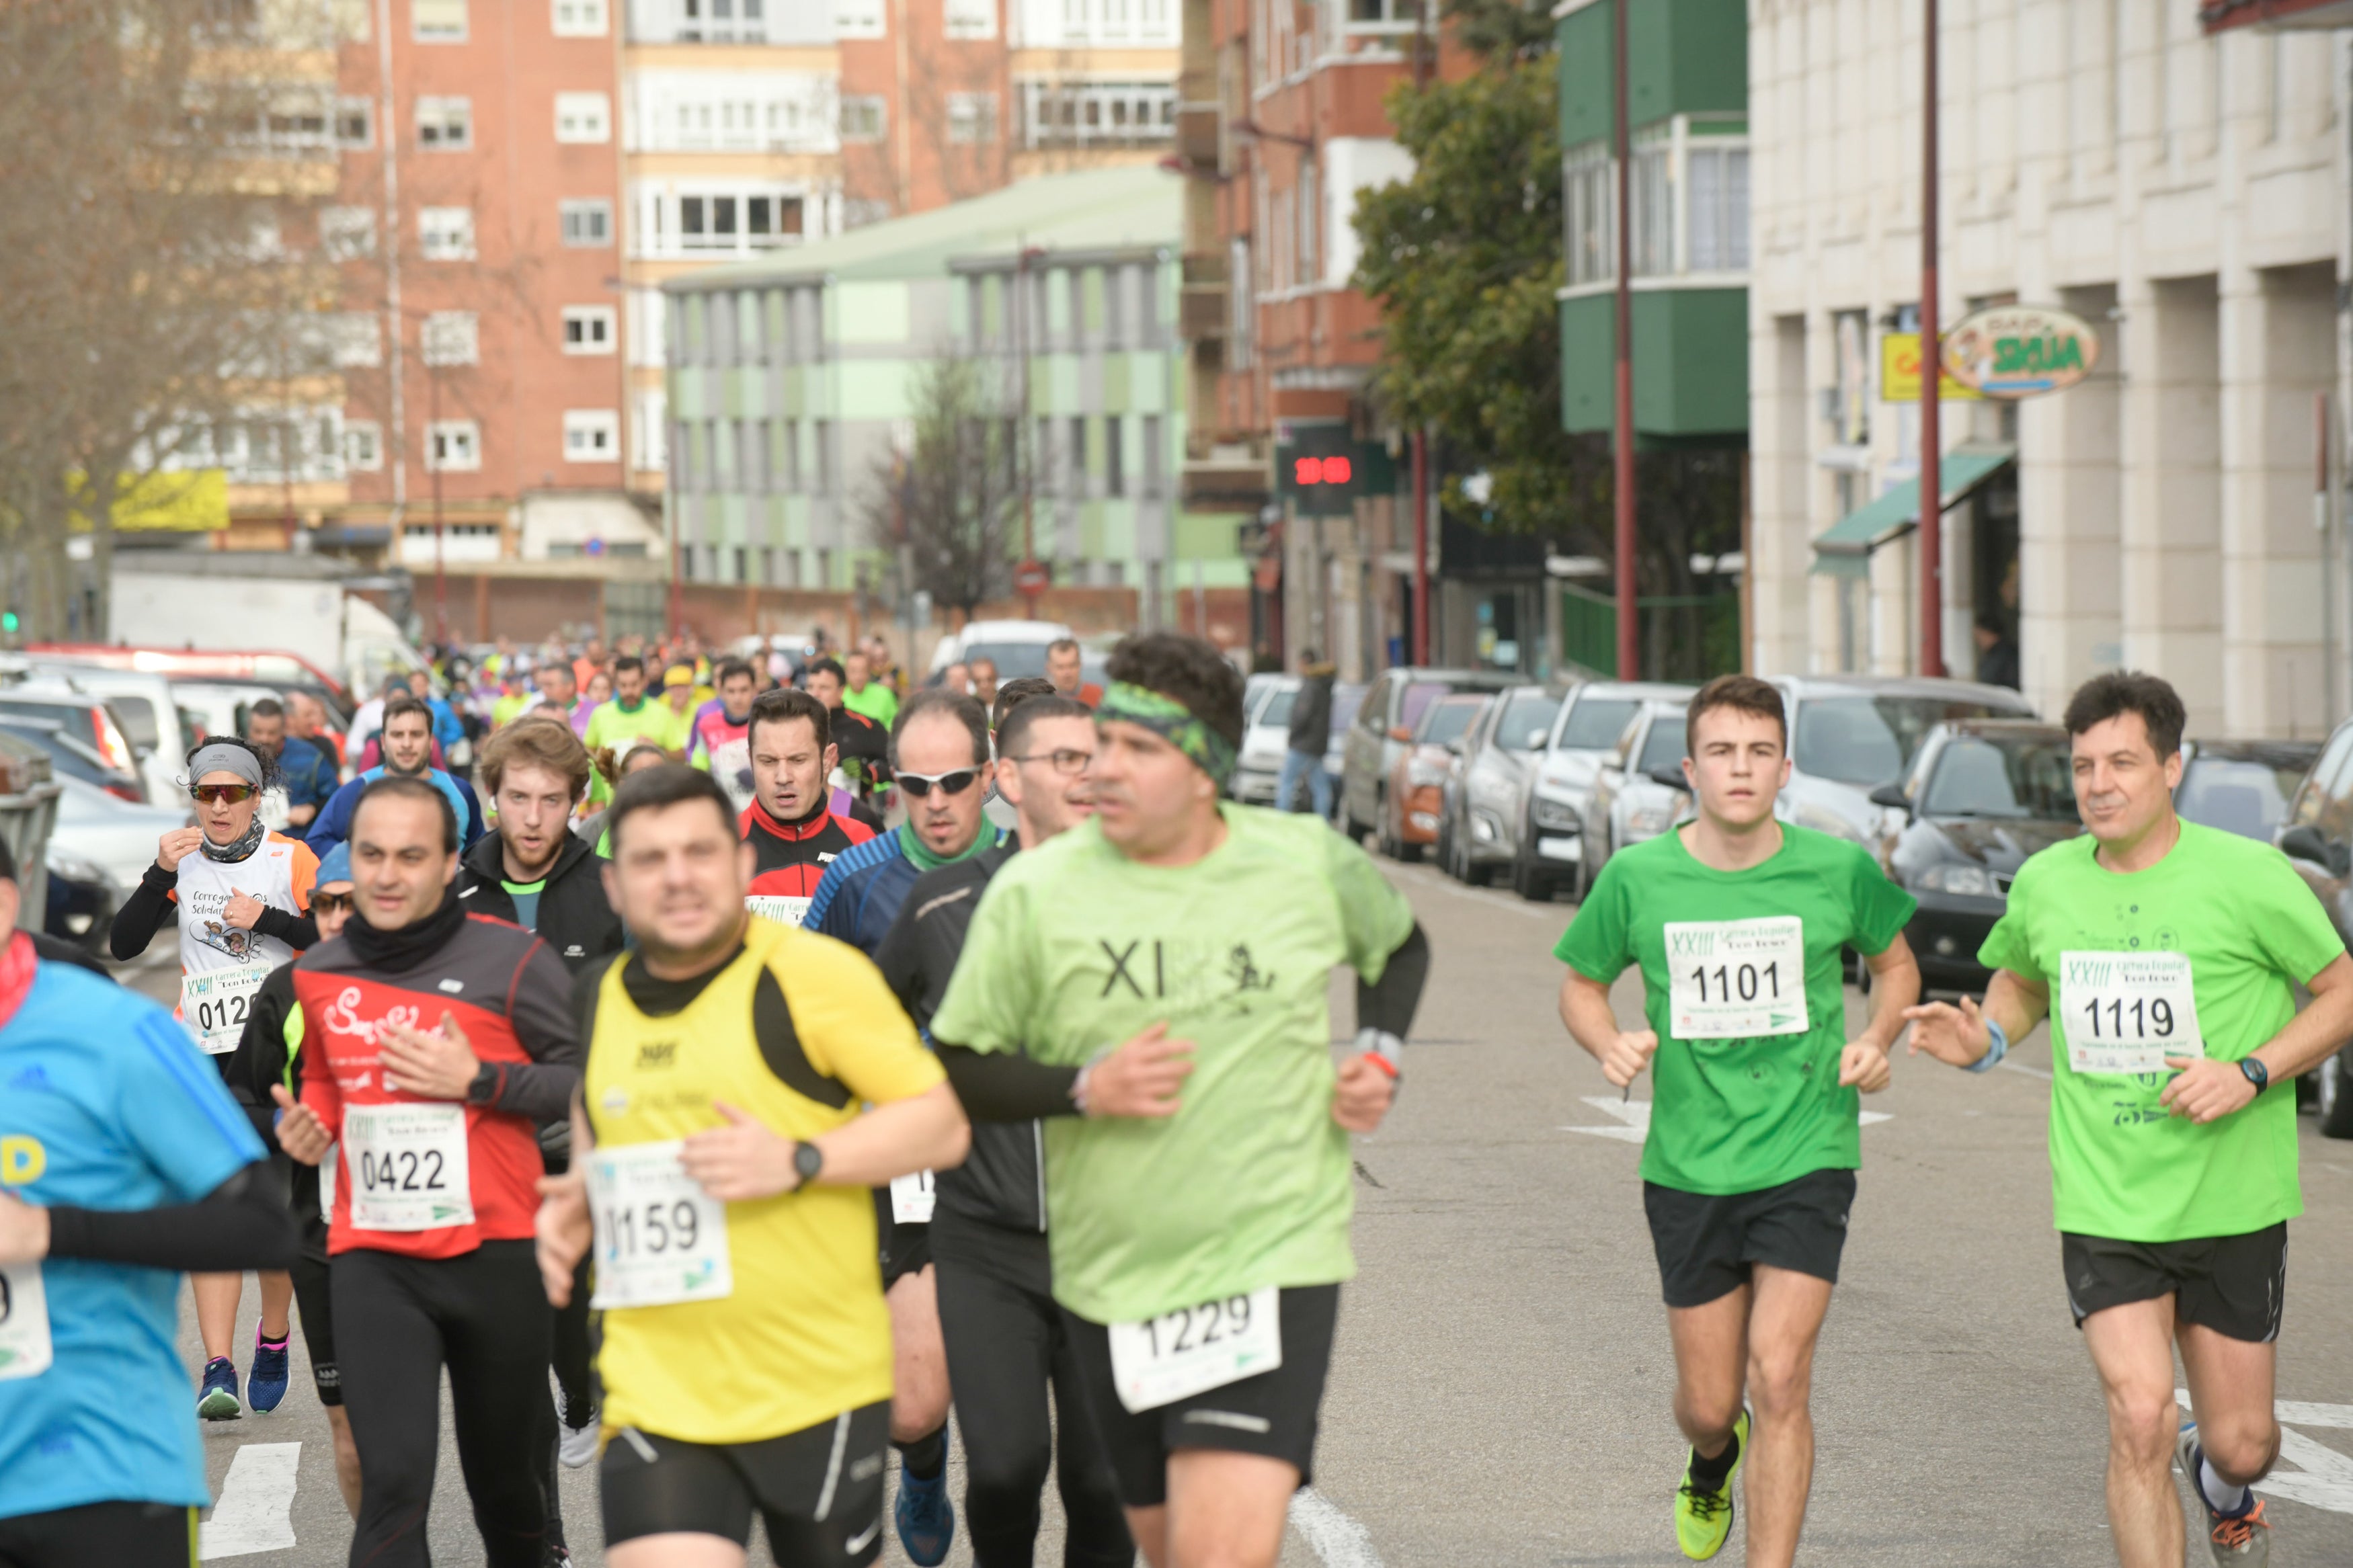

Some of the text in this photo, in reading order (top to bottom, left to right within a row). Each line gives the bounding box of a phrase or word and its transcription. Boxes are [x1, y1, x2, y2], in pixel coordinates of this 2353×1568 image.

[1671, 930, 1715, 957] XXIII
[188, 976, 213, 1000] XXIII
[1691, 960, 1778, 1002] 1101
[2067, 959, 2112, 988] XXIII
[198, 993, 259, 1030] 012
[2085, 997, 2174, 1037] 1119
[362, 1149, 446, 1191] 0422
[1140, 1294, 1251, 1358] 1229
